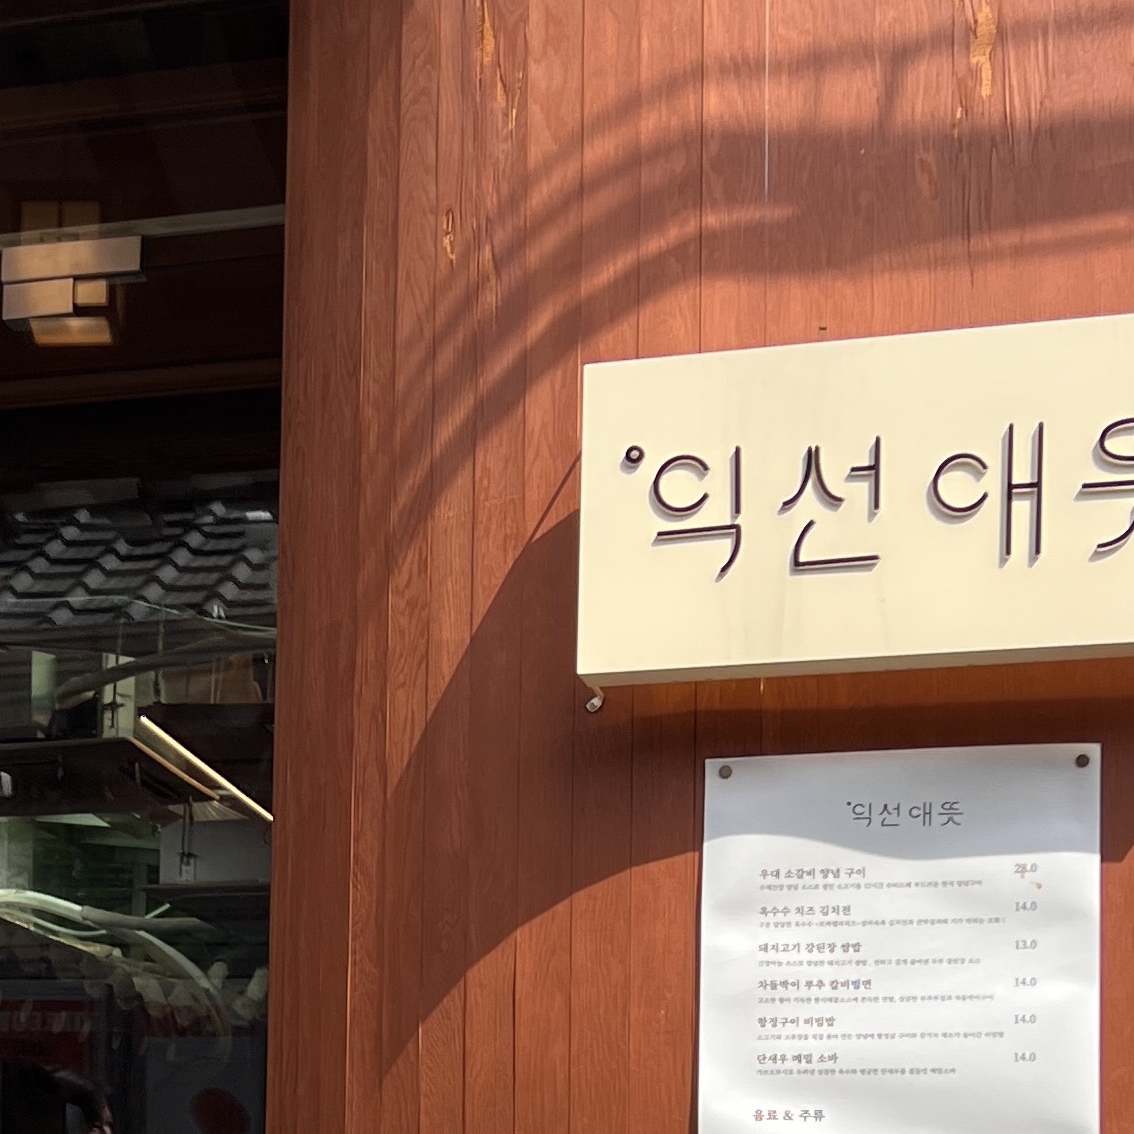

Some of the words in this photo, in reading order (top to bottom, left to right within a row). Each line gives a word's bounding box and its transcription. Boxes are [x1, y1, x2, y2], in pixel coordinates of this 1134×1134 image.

[760, 869, 780, 879] 우대
[784, 868, 815, 879] 소갈비
[820, 868, 840, 879] 양념
[844, 867, 865, 878] 구이
[759, 907, 790, 917] 옥수수
[795, 906, 815, 916] 치즈
[820, 905, 850, 916] 김치전
[1014, 902, 1038, 912] 14.0
[759, 943, 800, 953] 돼지고기
[805, 943, 837, 953] 강된장
[840, 942, 862, 953] 쌈밥
[1014, 939, 1037, 949] 13.0
[804, 980, 825, 990] 부추
[1013, 977, 1037, 988] 14.0
[804, 1017, 835, 1027] 비빔밥
[1013, 1014, 1037, 1024] 14.0
[757, 1054, 788, 1064] 단새우
[792, 1053, 812, 1064] 메밀
[817, 1053, 838, 1063] 소바
[1013, 1052, 1037, 1062] 14.0
[753, 1110, 778, 1121] 음료
[783, 1110, 793, 1120] &
[799, 1110, 825, 1122] 주류
